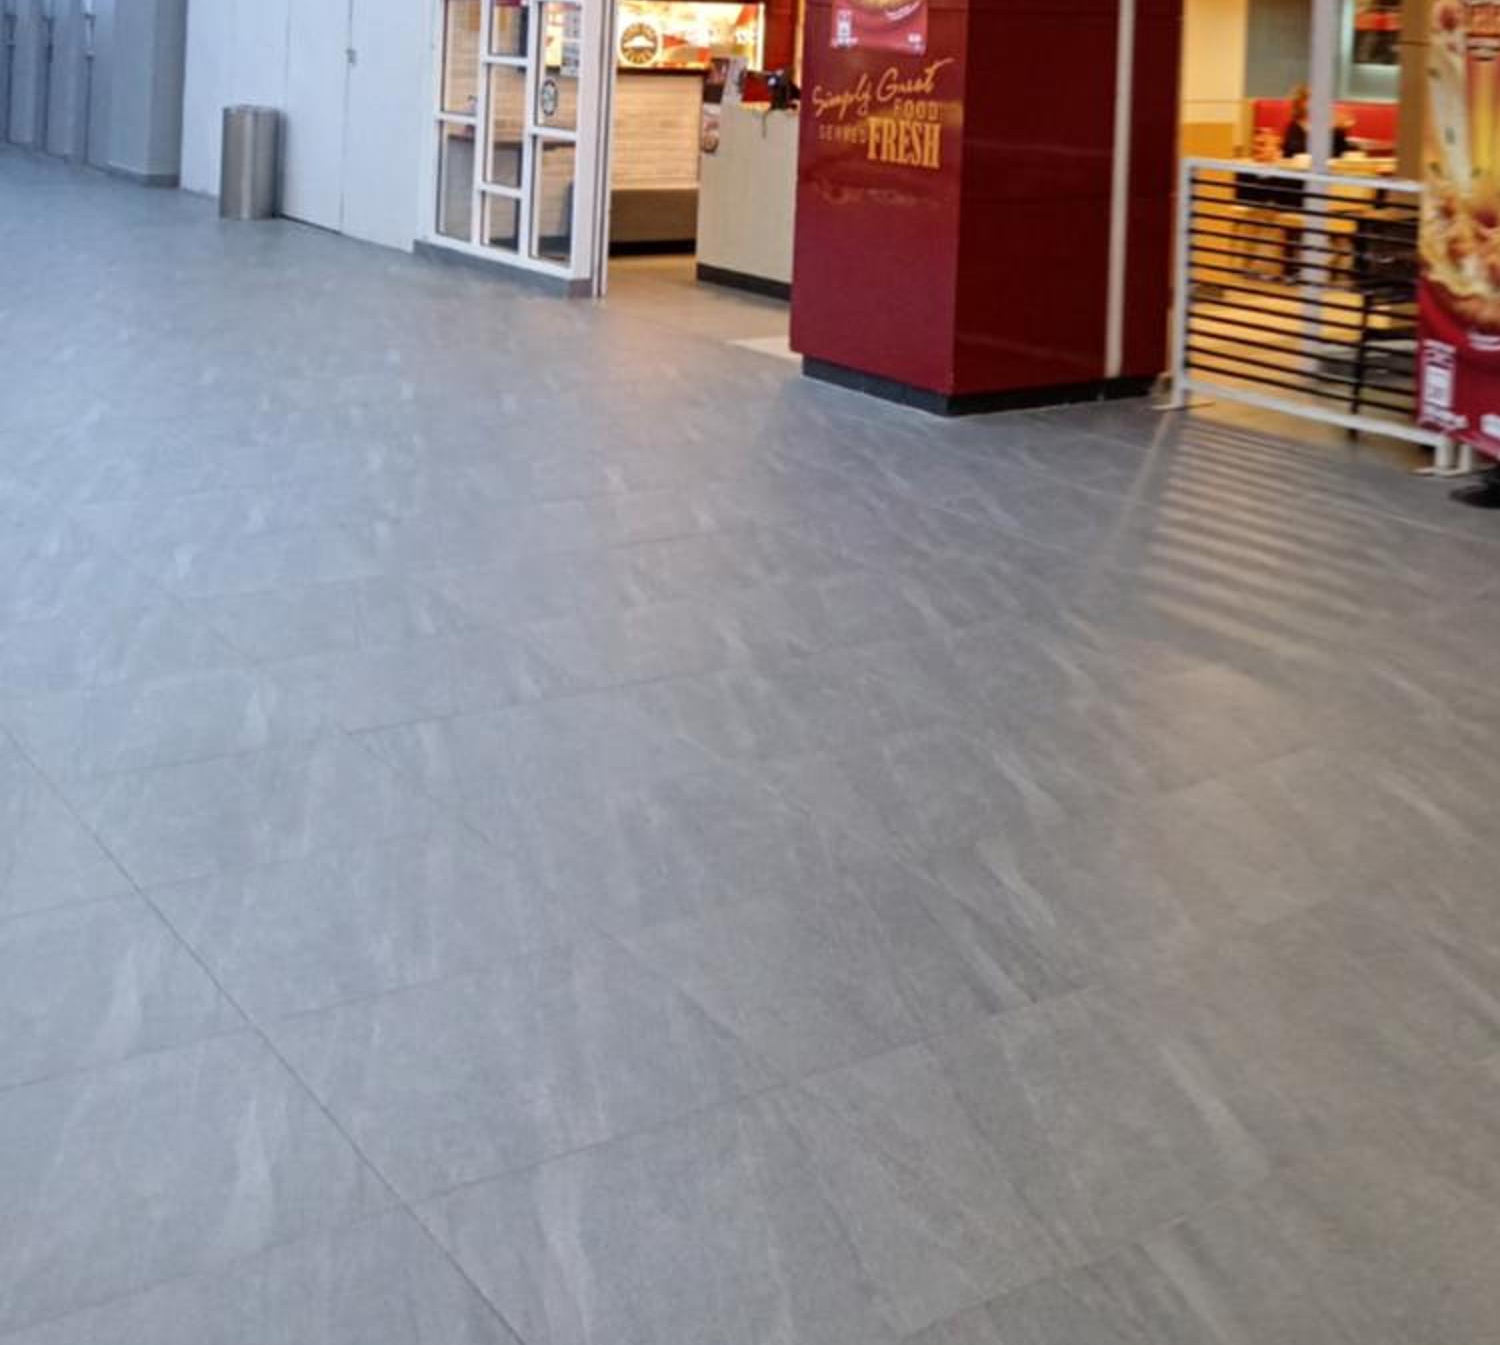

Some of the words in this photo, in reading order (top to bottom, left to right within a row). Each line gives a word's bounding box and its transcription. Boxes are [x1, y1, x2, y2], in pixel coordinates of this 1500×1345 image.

[811, 73, 874, 120] Simply
[893, 98, 941, 122] FOOD
[866, 115, 943, 170] FRESH
